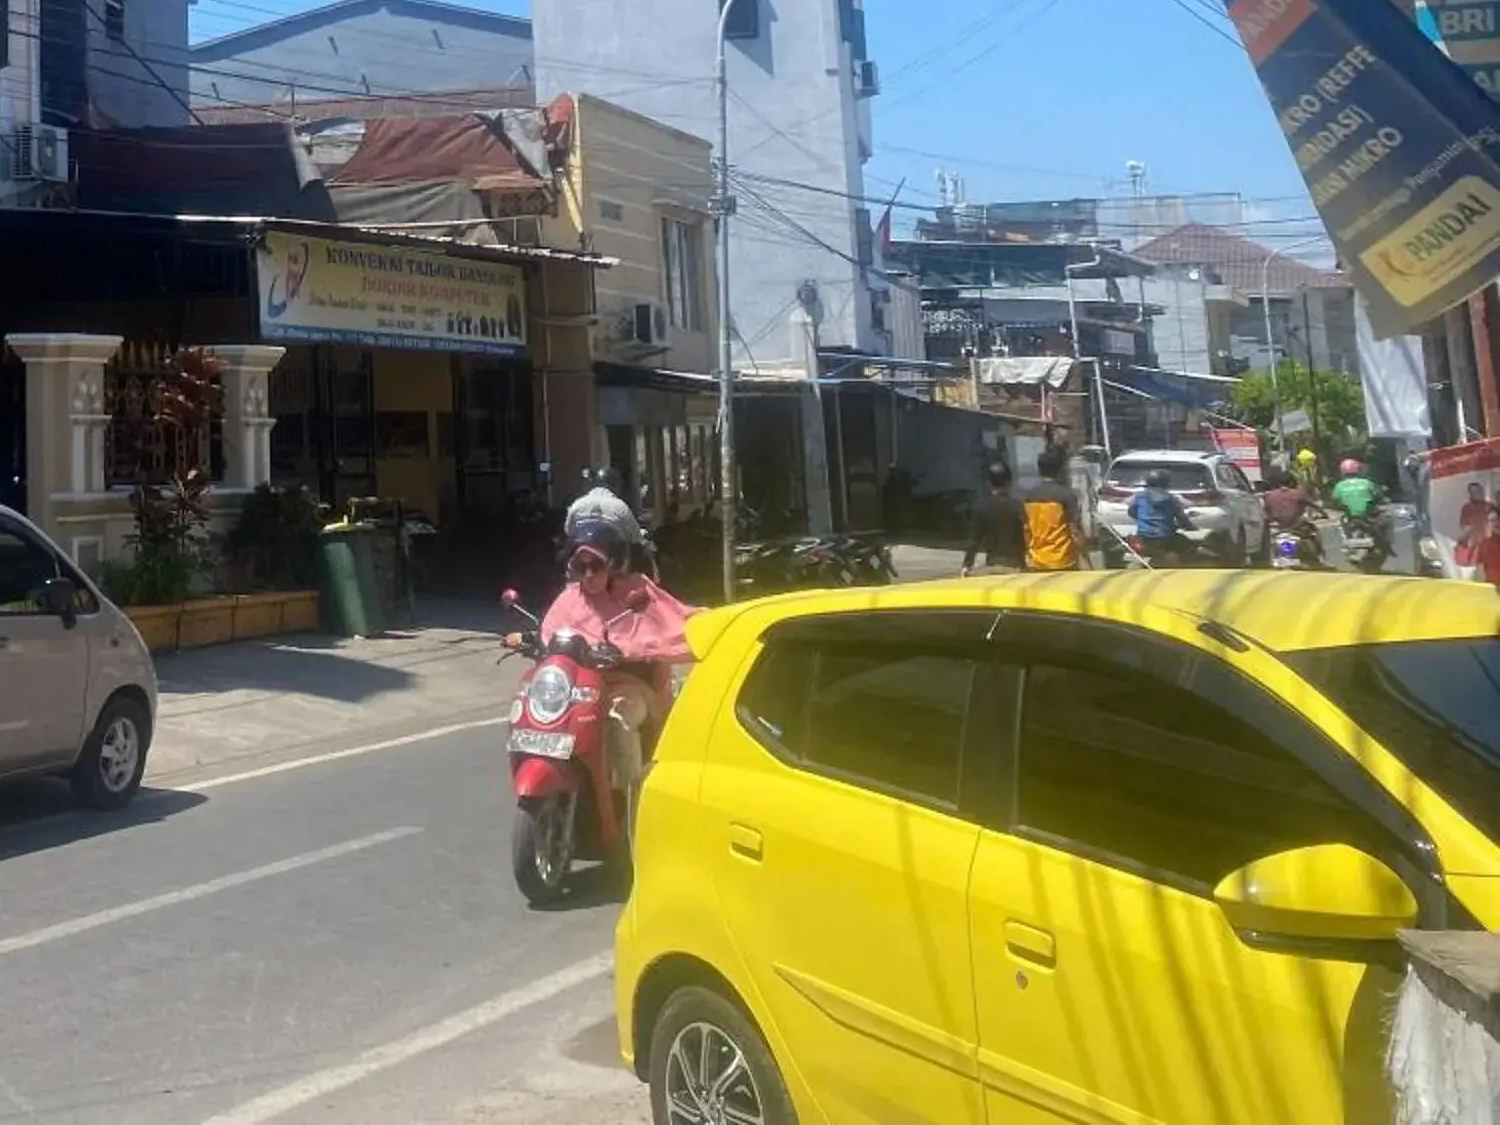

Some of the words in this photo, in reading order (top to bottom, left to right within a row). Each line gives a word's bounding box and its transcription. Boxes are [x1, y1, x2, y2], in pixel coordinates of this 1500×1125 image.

[1440, 7, 1495, 35] BRI
[1338, 126, 1404, 182] MIKRO
[1403, 191, 1493, 263] PANDAI
